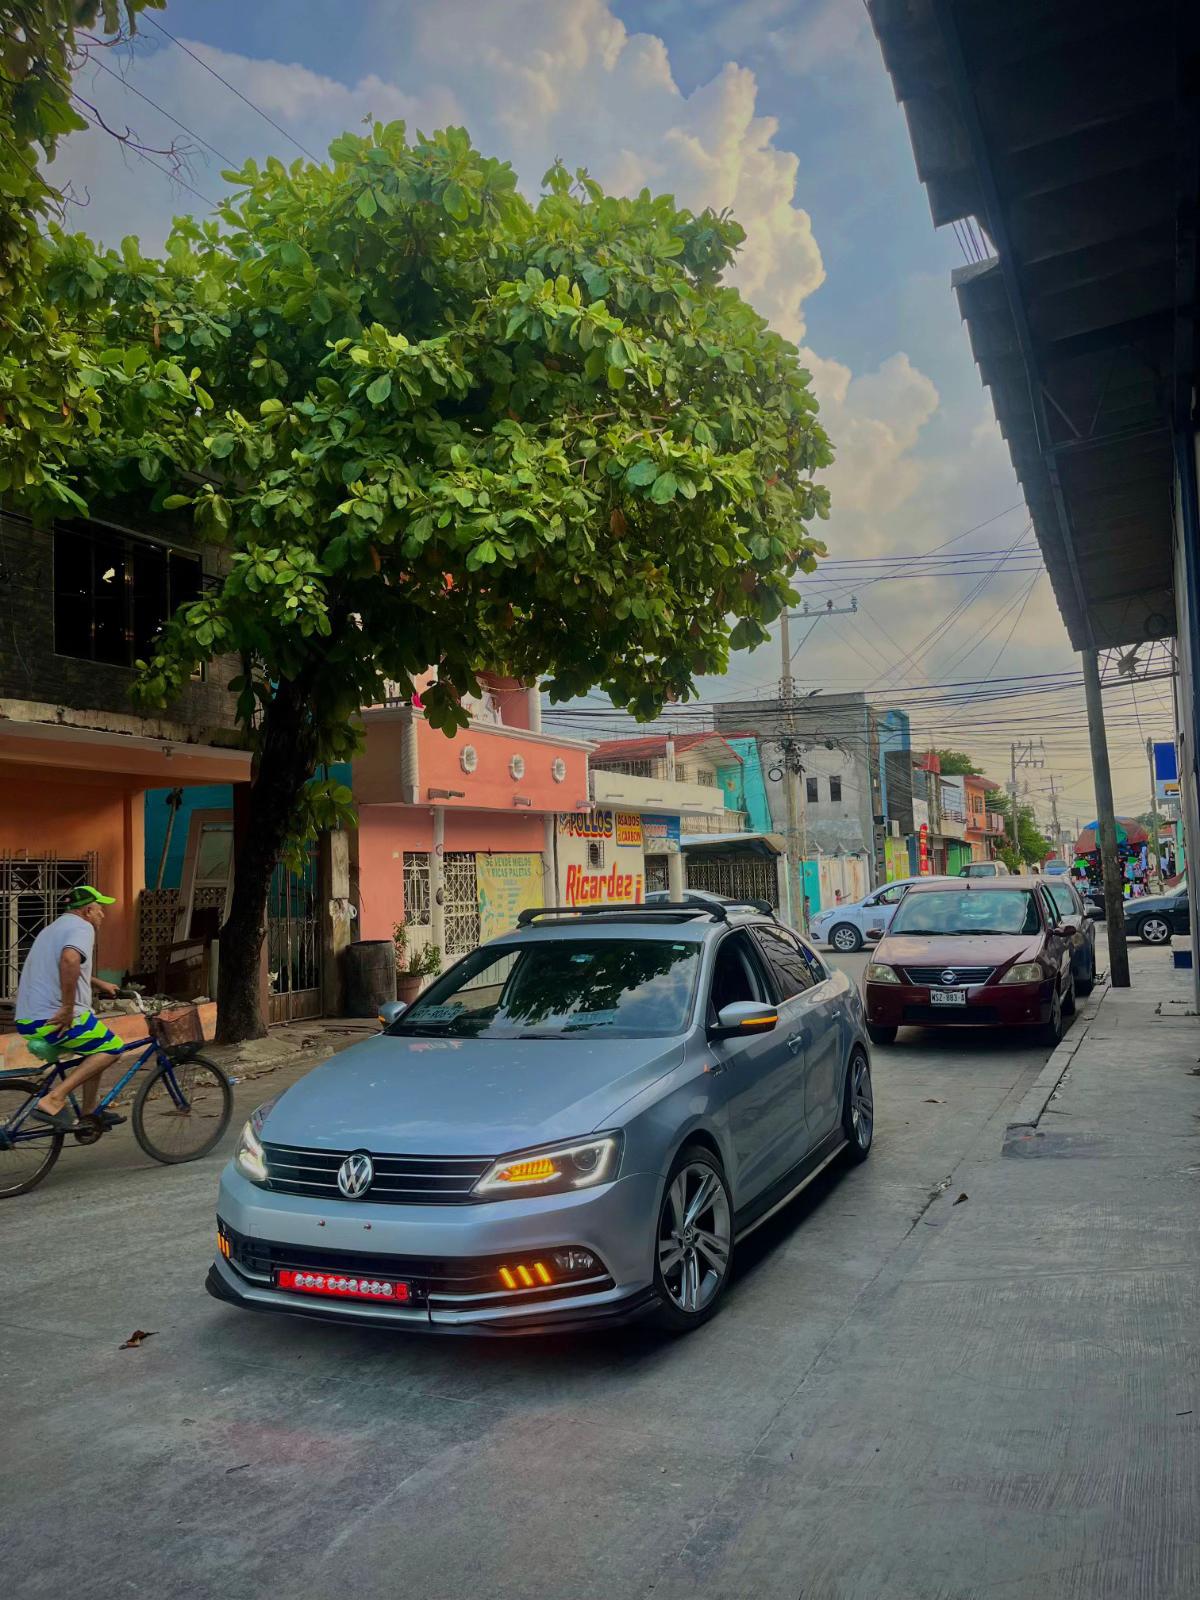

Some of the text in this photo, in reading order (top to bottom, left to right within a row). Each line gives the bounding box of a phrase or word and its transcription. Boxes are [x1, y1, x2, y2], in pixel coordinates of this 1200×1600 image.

[568, 809, 613, 837] POLLOS
[618, 814, 640, 828] ASADOS
[565, 862, 633, 906] Ricardez
